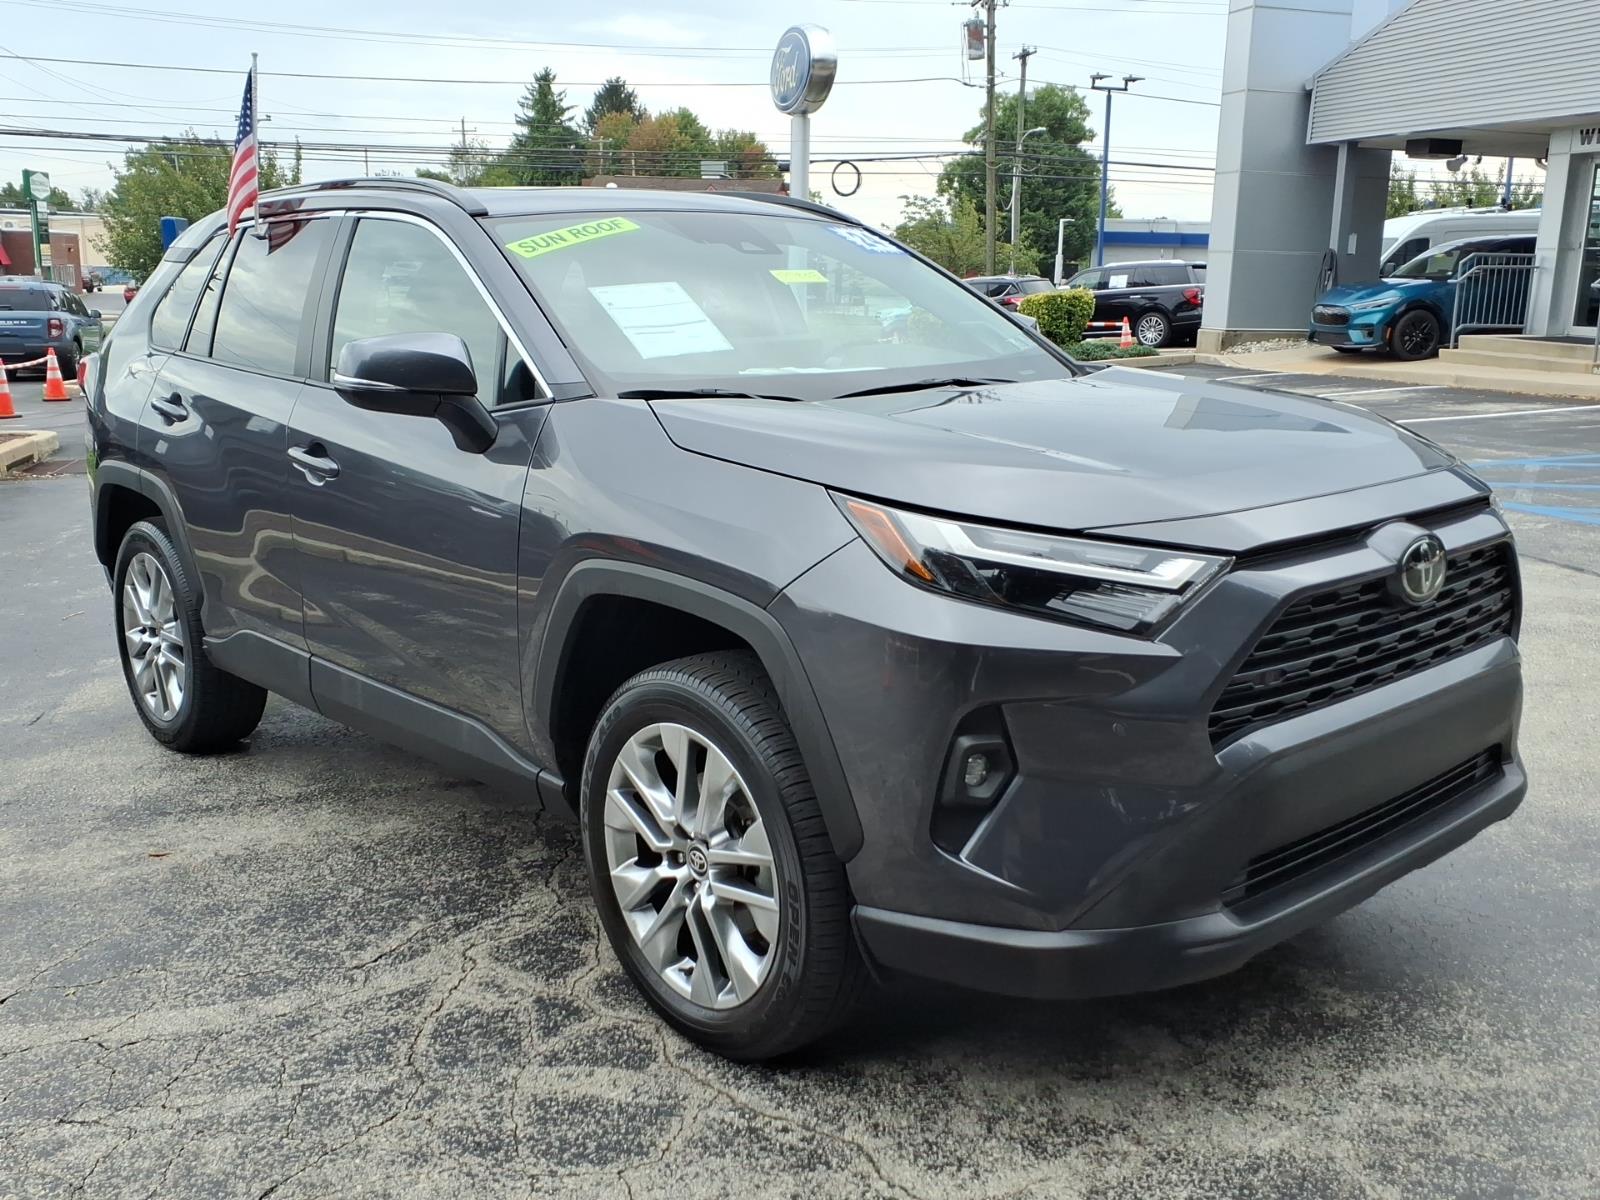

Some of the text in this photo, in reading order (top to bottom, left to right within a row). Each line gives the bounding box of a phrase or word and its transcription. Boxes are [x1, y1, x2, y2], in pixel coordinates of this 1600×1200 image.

[773, 44, 799, 96] Ford
[518, 218, 624, 253] SUN ROOF
[786, 879, 801, 967] OPEN
